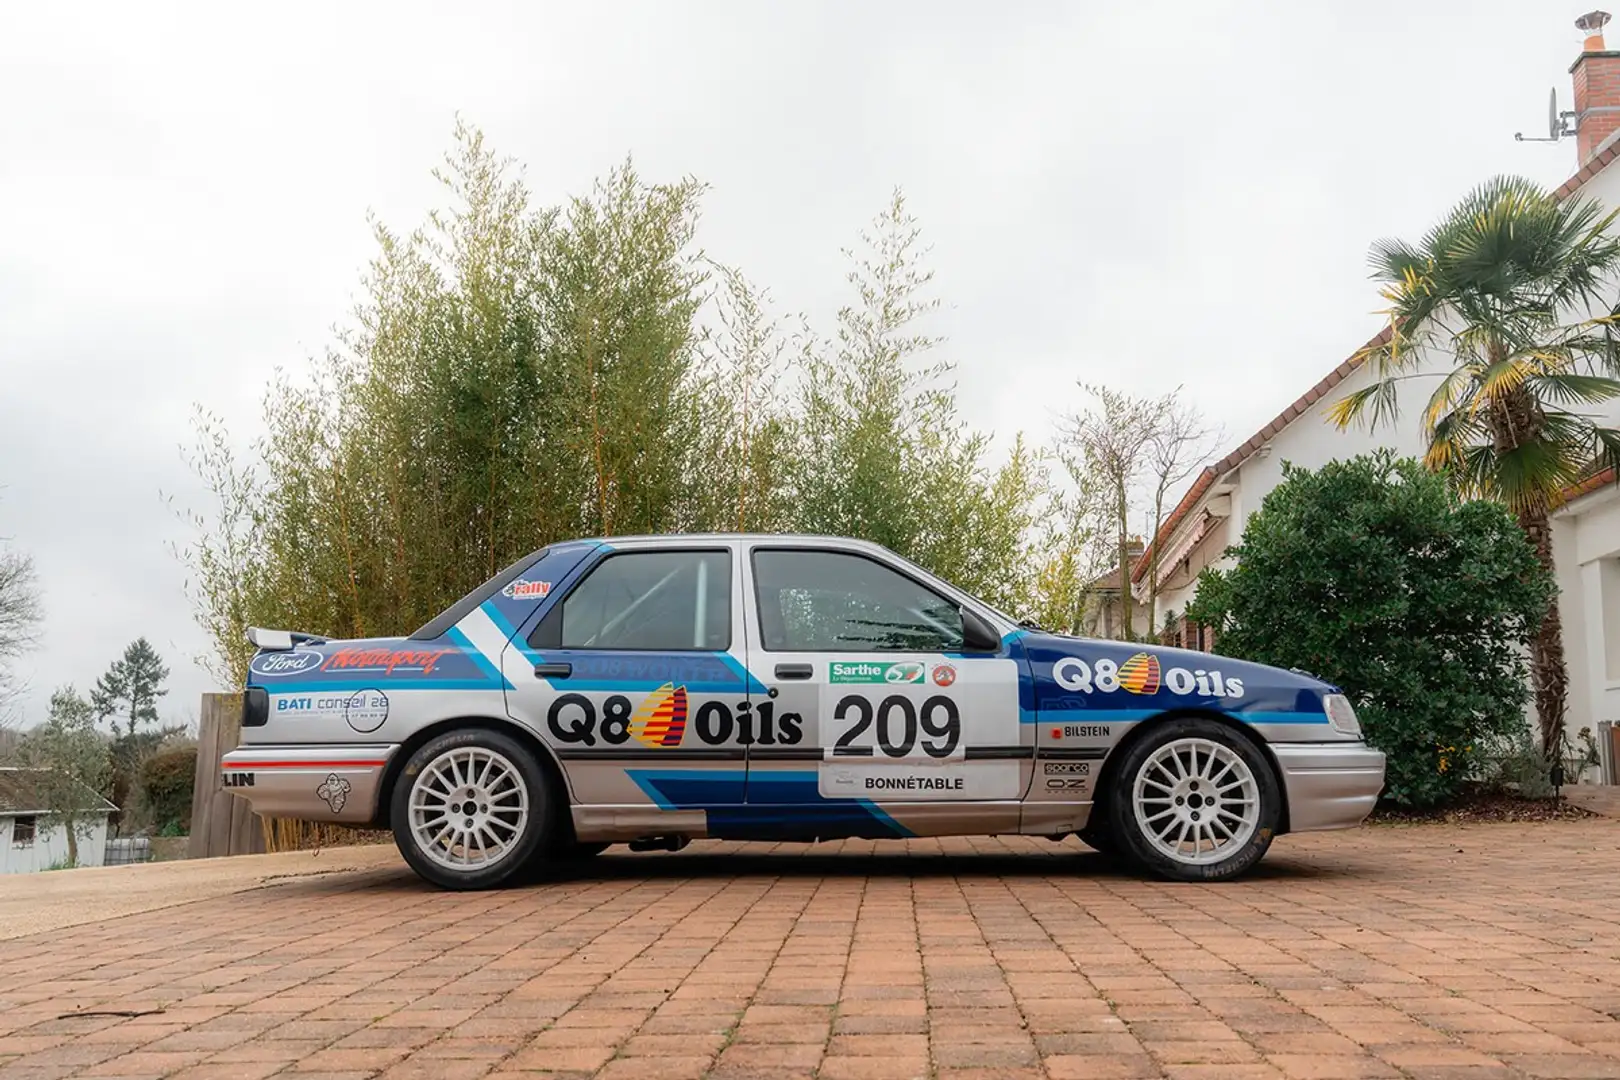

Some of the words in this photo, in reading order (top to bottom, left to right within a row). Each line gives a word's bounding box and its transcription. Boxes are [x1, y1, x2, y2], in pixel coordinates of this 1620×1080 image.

[514, 582, 550, 595] rally
[262, 653, 308, 671] Ford
[320, 648, 457, 675] Motorsport
[833, 664, 881, 676] Sarthe
[1052, 657, 1121, 694] Q8
[1165, 667, 1244, 698] Oils
[277, 698, 312, 710] BATI
[317, 694, 366, 709] conseil
[371, 697, 389, 708] 28
[547, 693, 632, 747] Q8
[695, 701, 803, 745] Oils
[832, 695, 961, 758] 209
[1064, 726, 1110, 737] BILSTEIN
[221, 773, 255, 786] LIN
[865, 775, 964, 790] BONNÉTABLE
